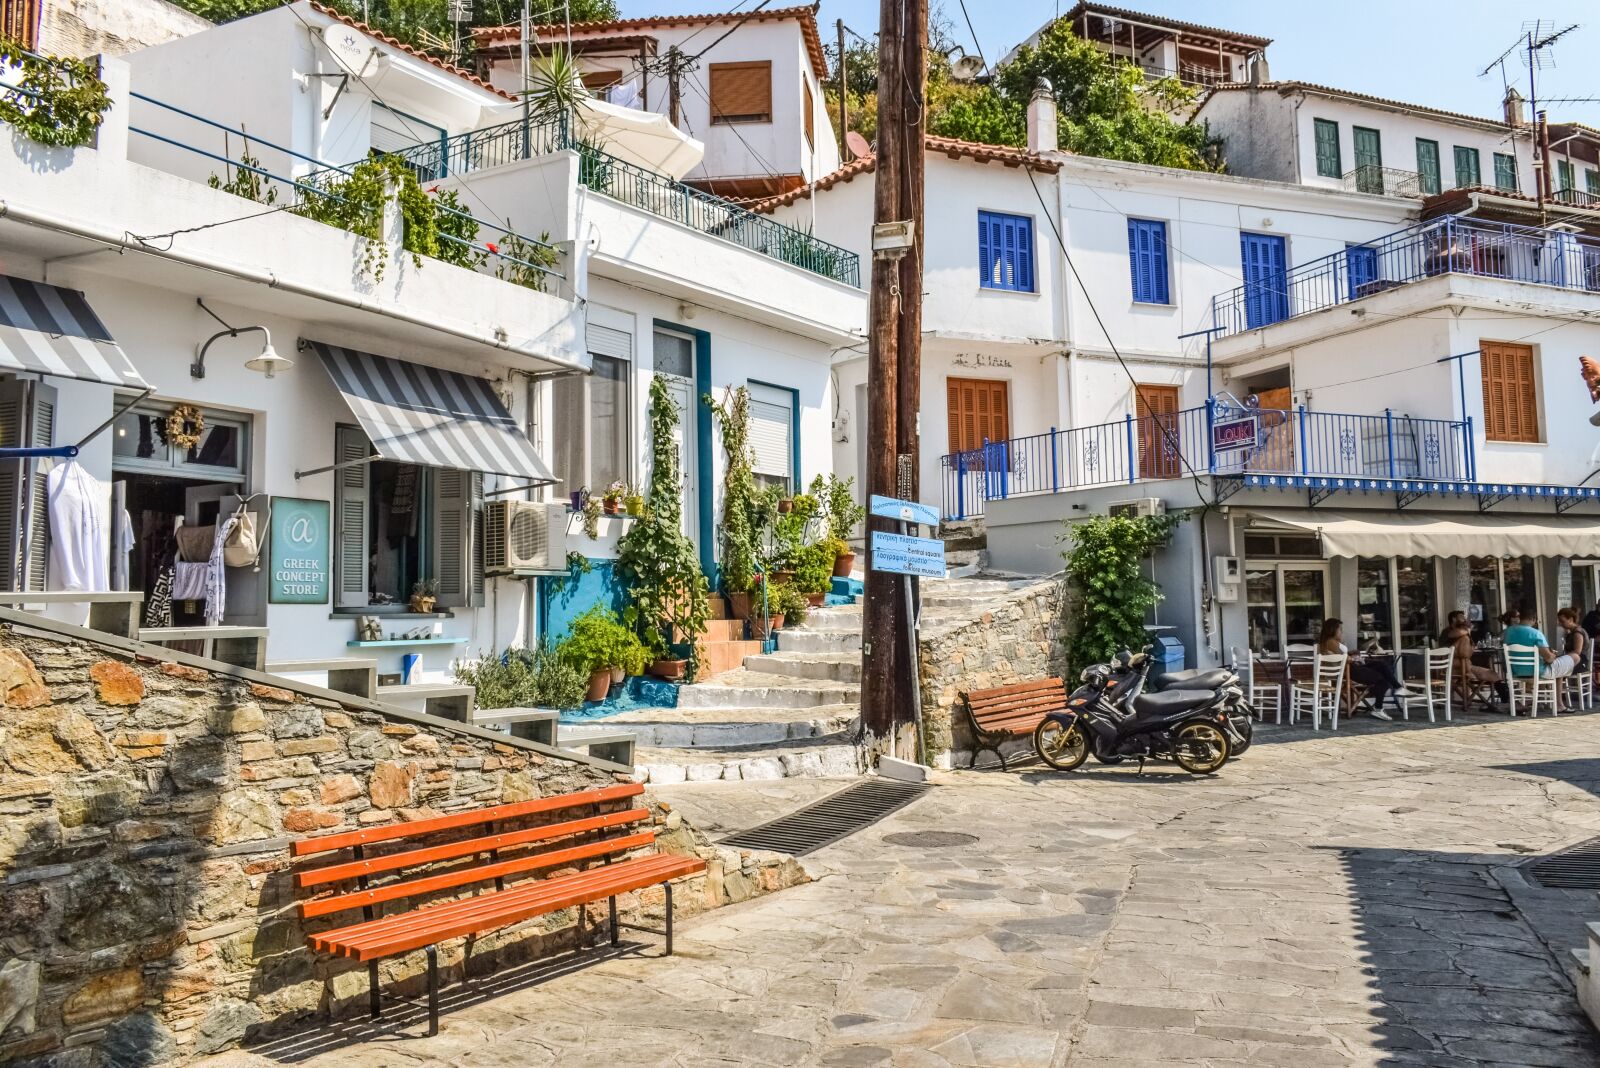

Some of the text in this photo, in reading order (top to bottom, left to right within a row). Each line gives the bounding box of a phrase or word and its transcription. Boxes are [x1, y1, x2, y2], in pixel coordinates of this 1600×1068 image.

[283, 558, 319, 569] GREEK
[276, 571, 326, 582] CONCEPT
[921, 568, 942, 576] museum
[283, 584, 320, 595] STORE
